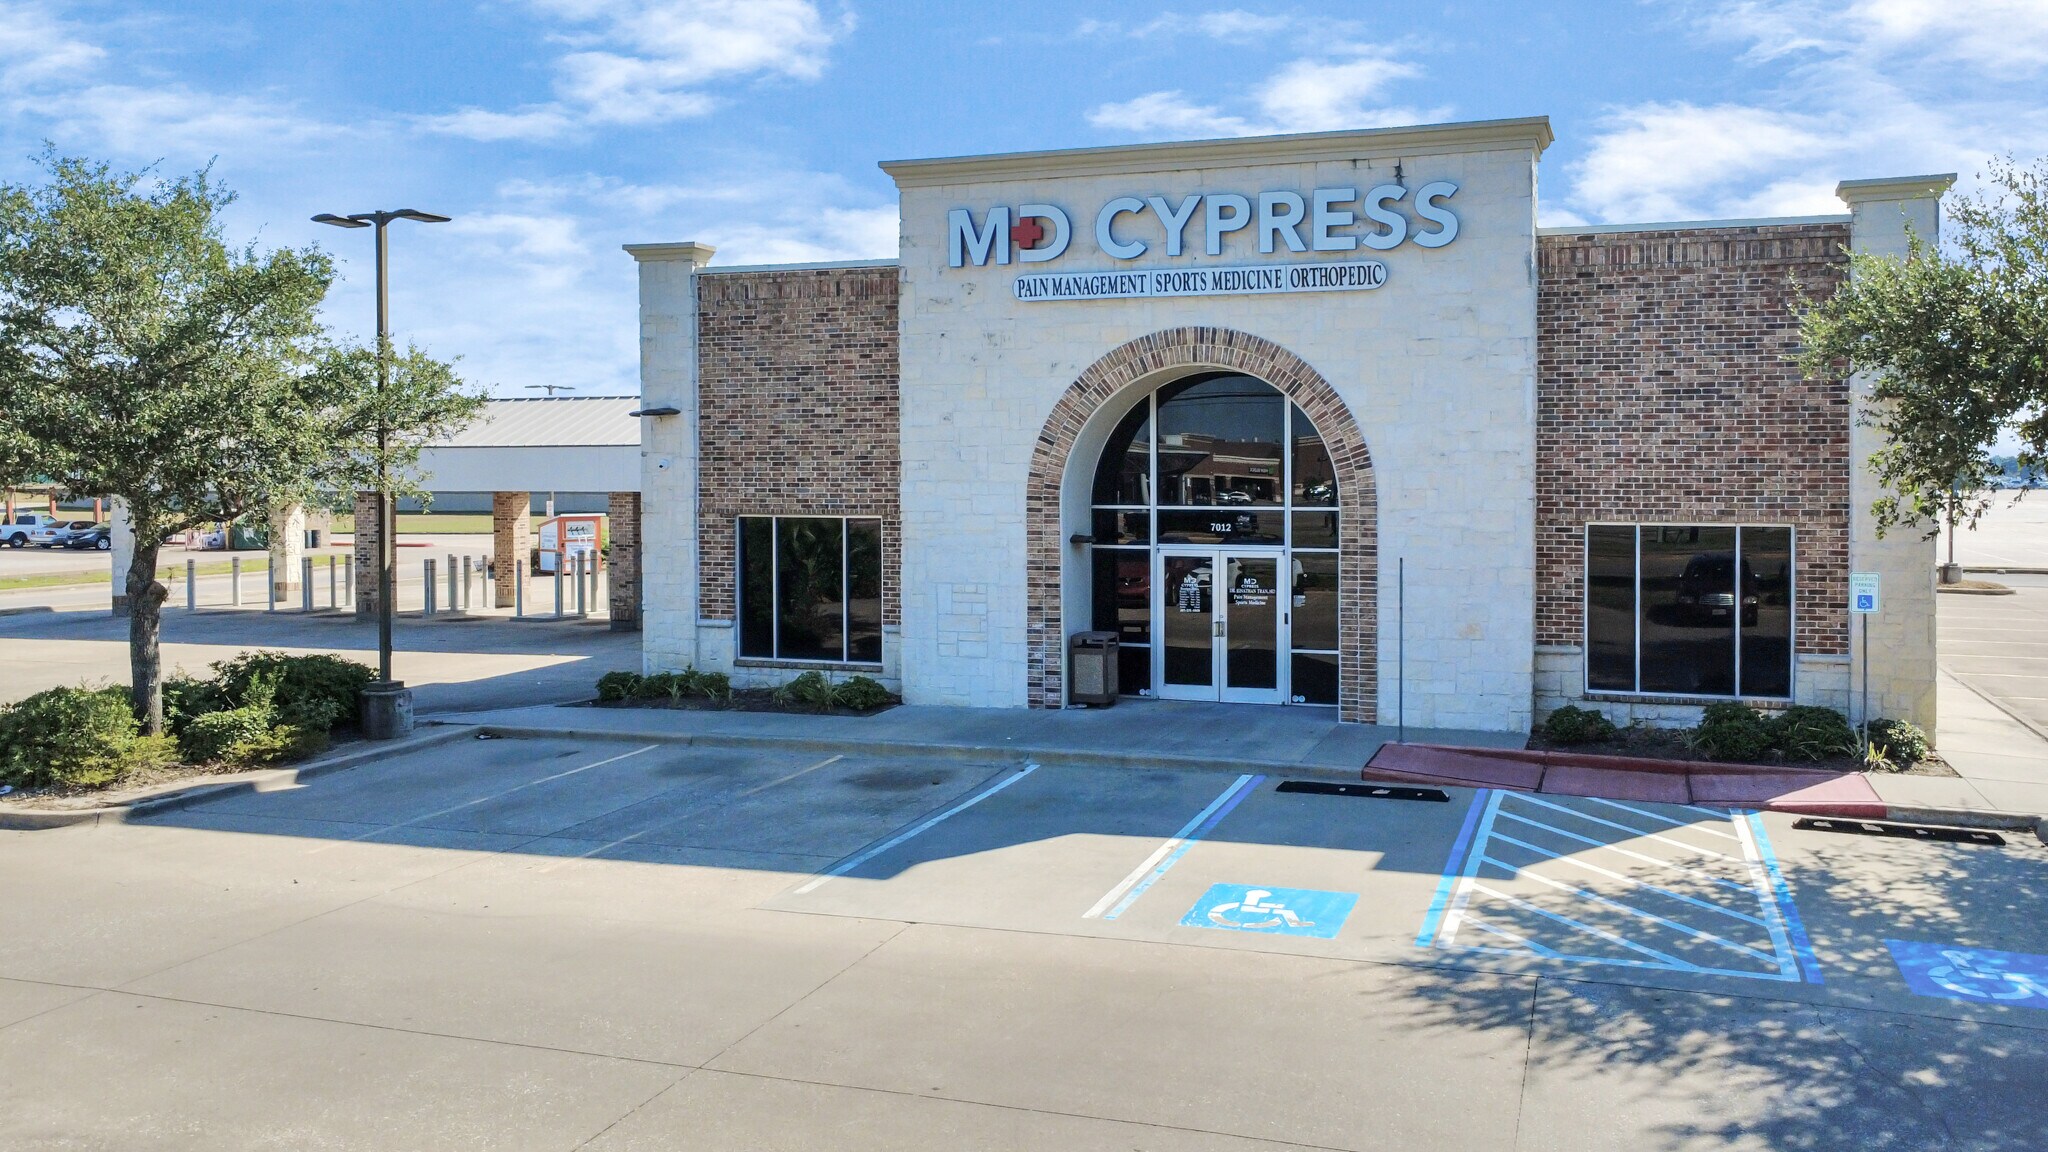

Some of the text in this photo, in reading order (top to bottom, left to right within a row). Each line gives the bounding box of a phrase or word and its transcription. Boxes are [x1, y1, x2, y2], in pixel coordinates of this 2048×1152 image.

[948, 181, 1459, 268] MD CYPRESS
[1017, 264, 1383, 298] PAIN MANAGEMENT SPORTS MEDICINE ORTHOPEDIC
[1210, 522, 1232, 532] 7012
